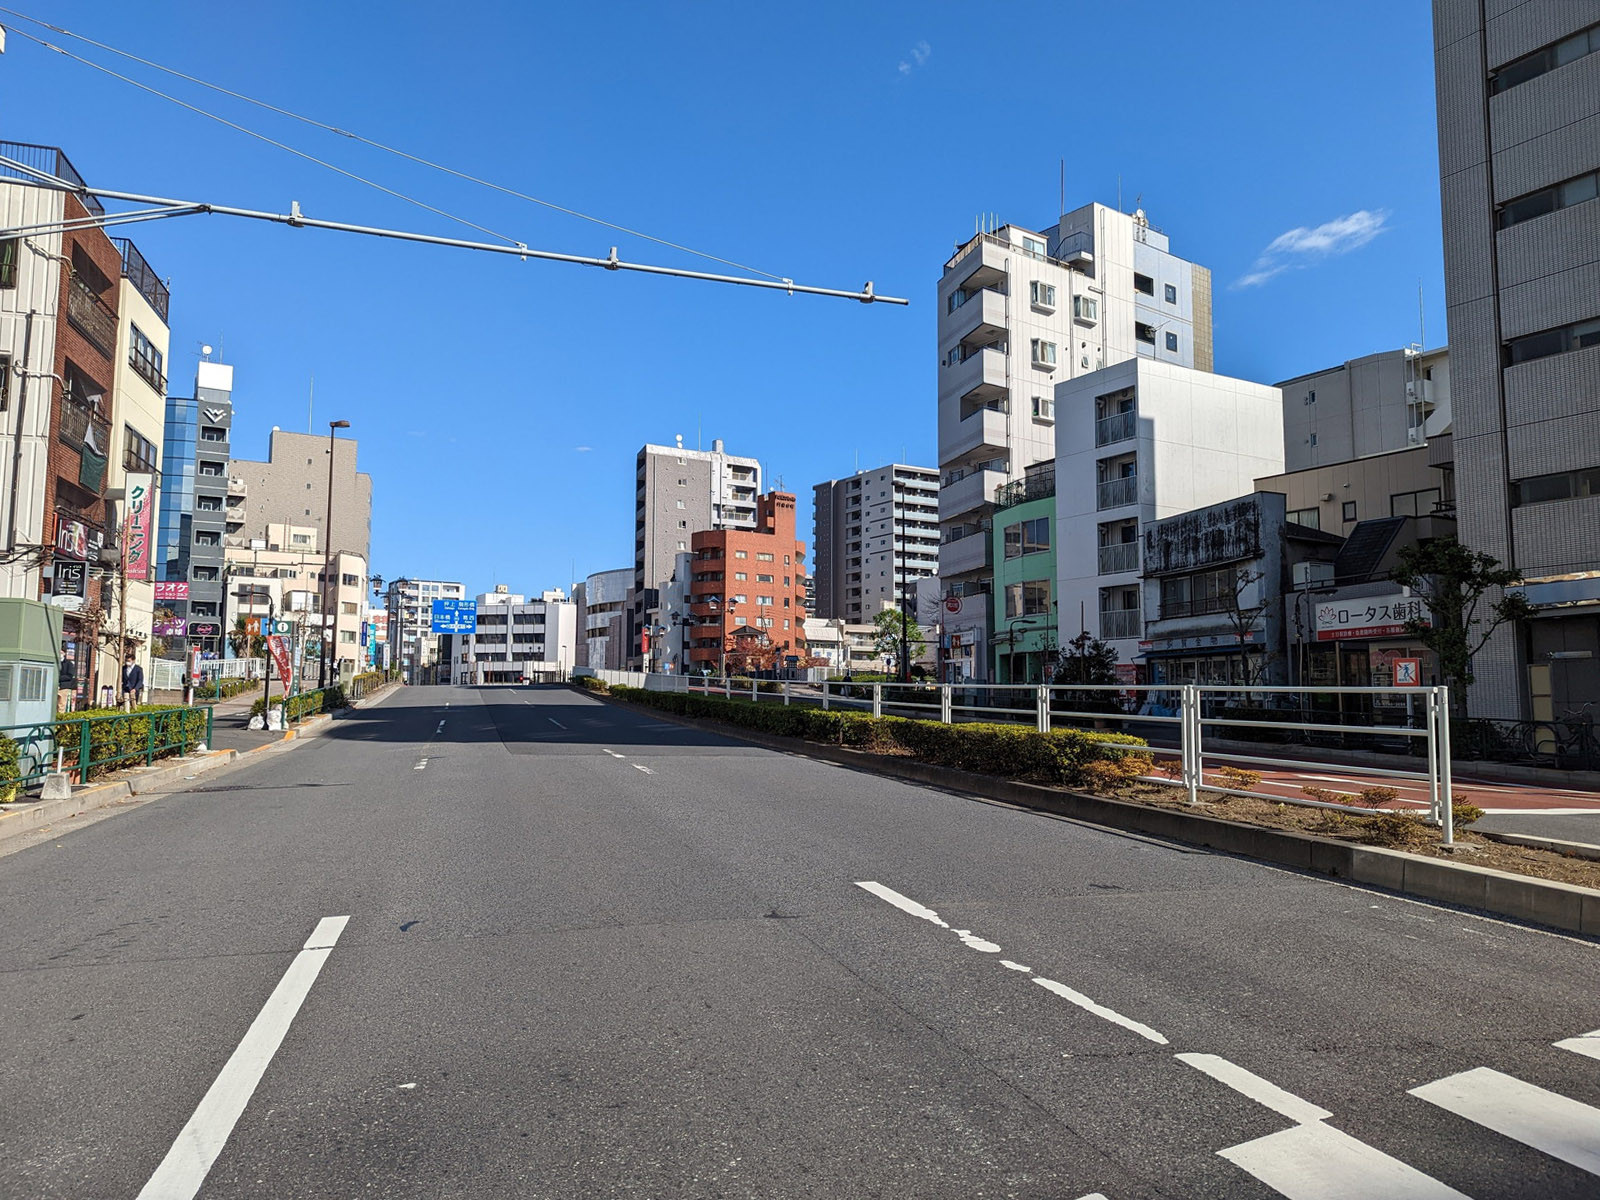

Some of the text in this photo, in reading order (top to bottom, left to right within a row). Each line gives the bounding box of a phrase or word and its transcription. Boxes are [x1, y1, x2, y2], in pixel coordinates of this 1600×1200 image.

[58, 519, 74, 552] Iris
[128, 485, 145, 564] クリーニング
[58, 564, 81, 579] Iris
[1338, 600, 1422, 624] ロータス歯科
